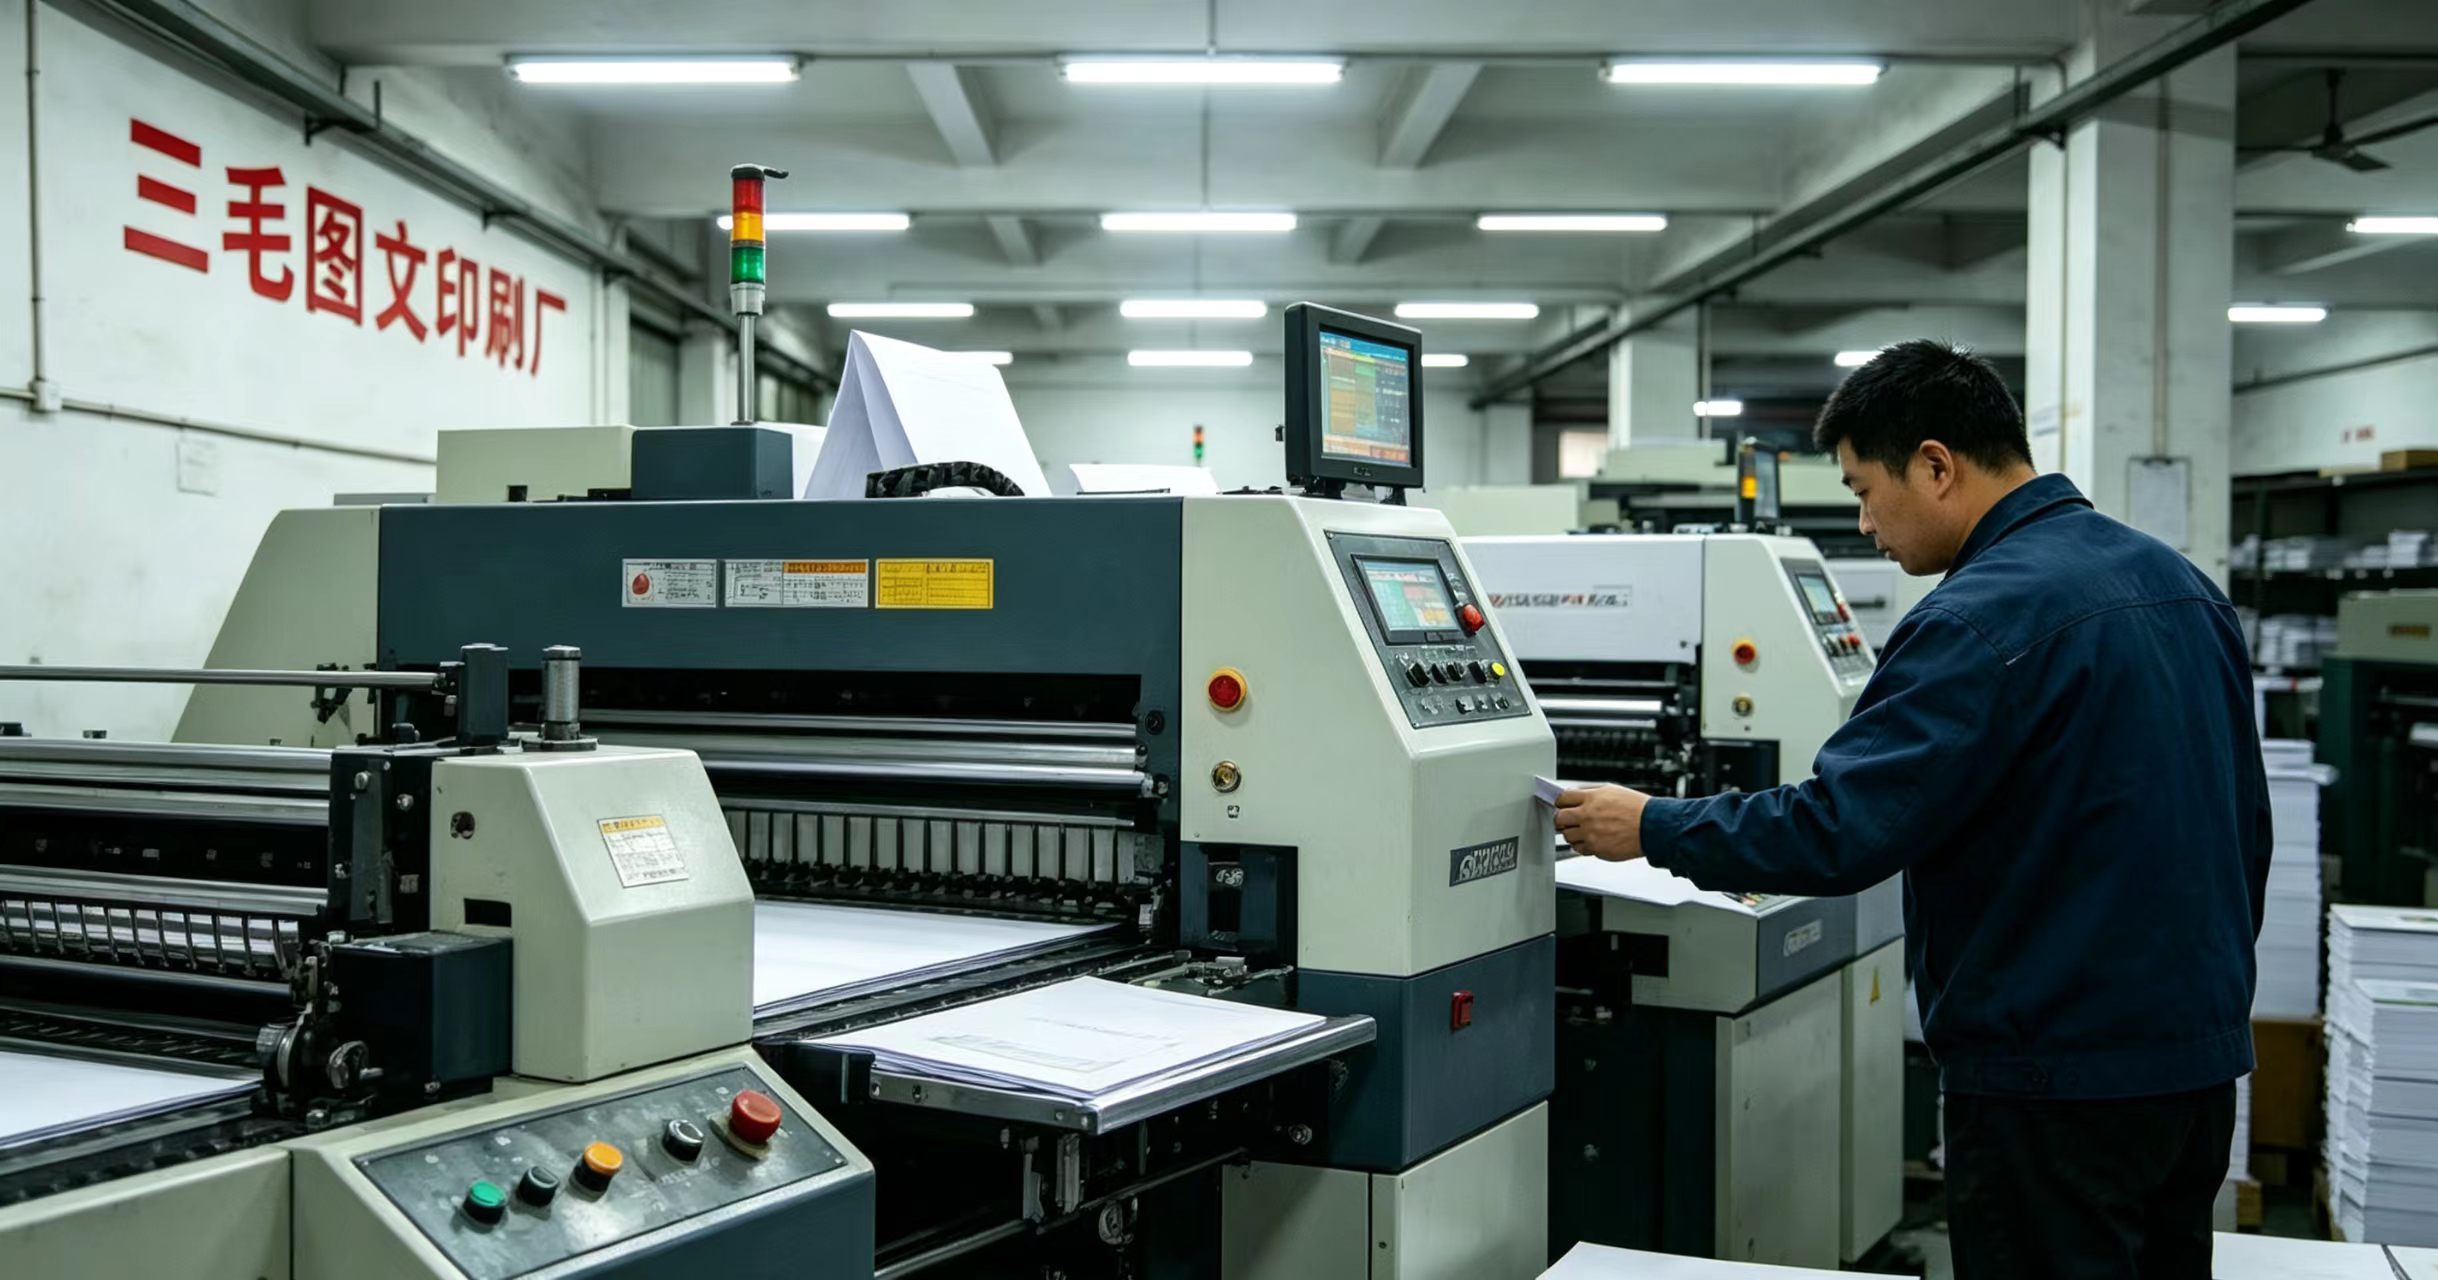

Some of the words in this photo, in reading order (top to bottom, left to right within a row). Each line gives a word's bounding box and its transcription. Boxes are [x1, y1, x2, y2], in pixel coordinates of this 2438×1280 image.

[123, 118, 567, 376] 三毛图文印刷厂
